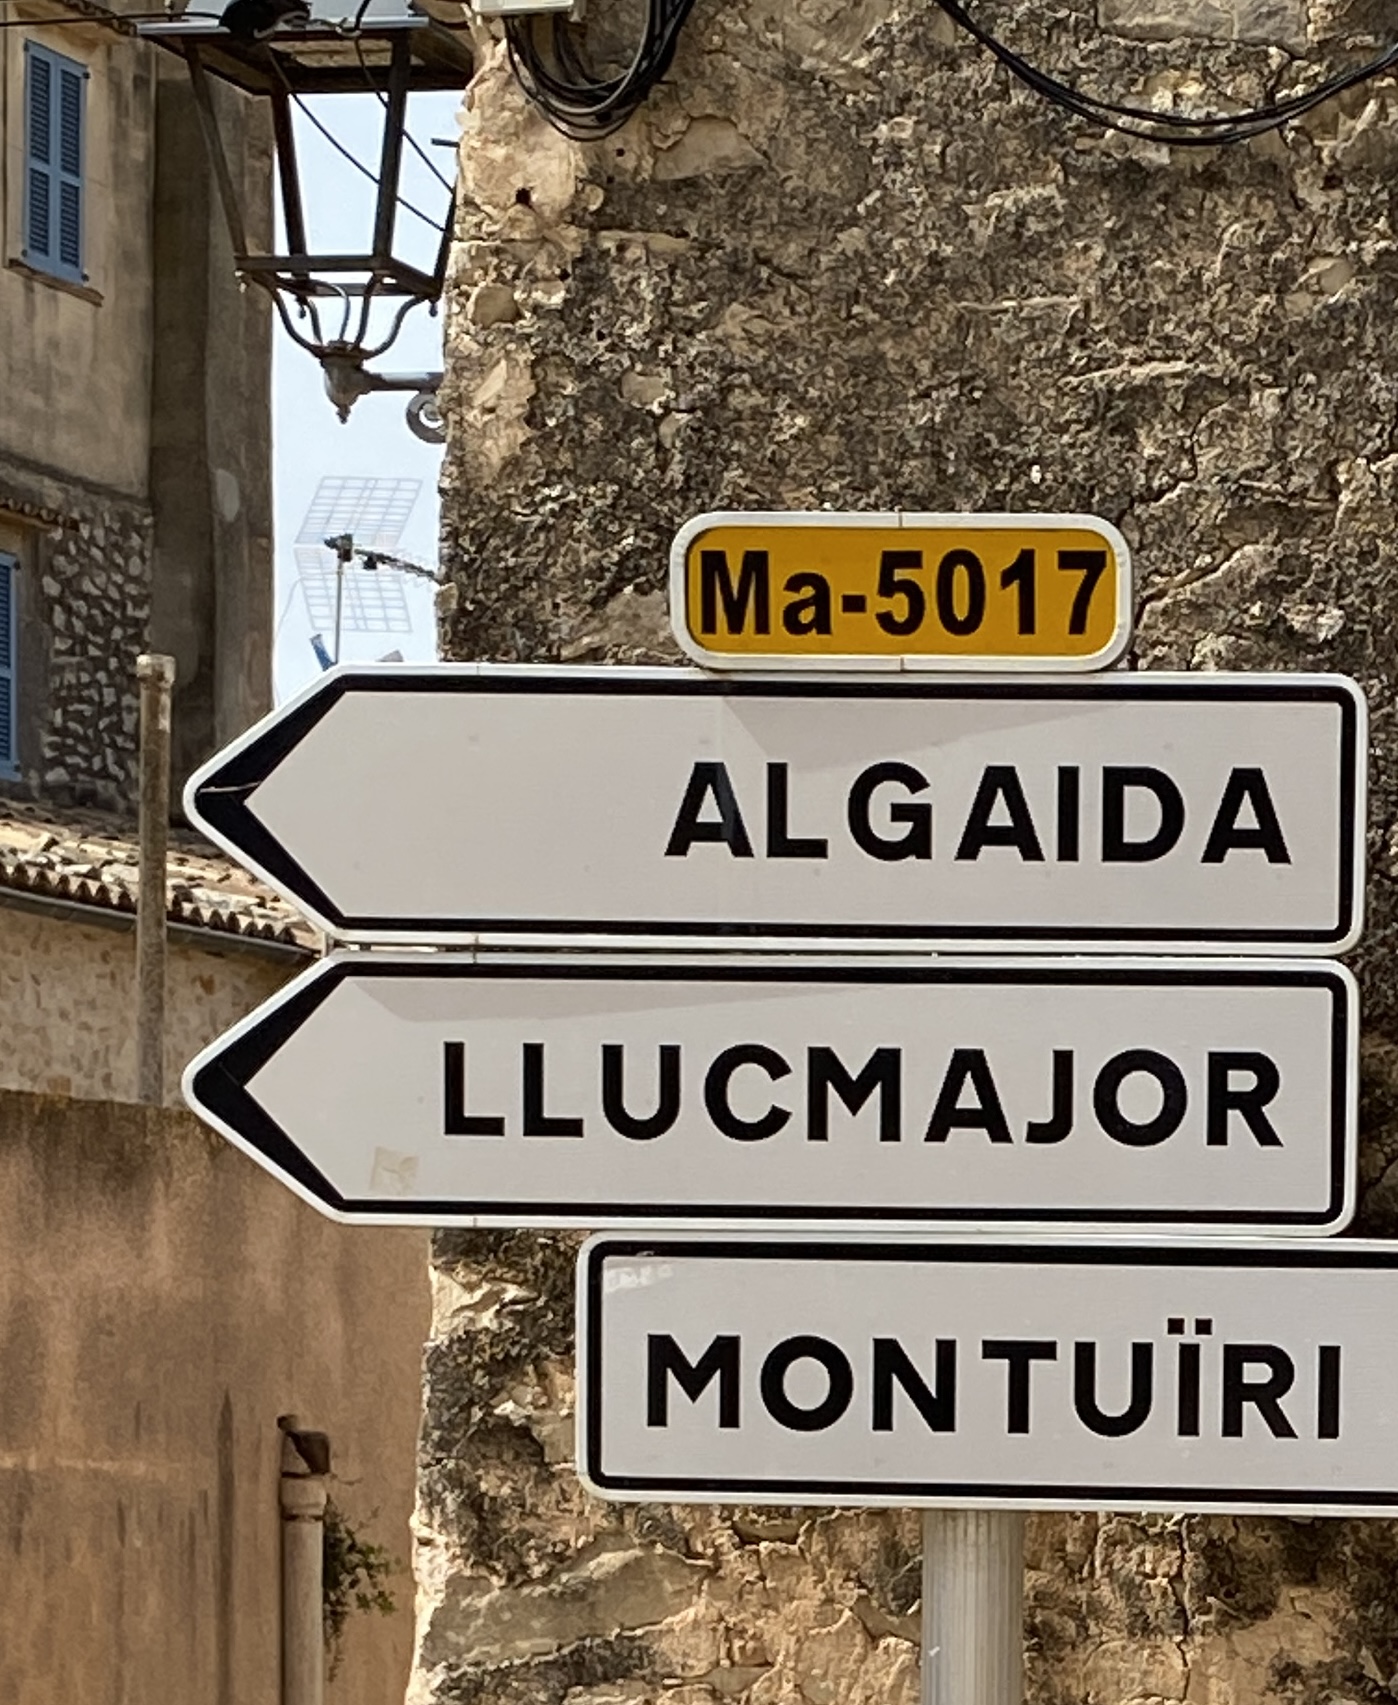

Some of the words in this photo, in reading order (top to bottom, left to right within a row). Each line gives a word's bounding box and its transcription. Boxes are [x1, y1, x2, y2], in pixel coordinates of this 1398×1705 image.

[700, 548, 1107, 636] Ma-5017
[665, 761, 1291, 864] ALGAIDA
[443, 1041, 1283, 1147] LLUCMAJOR
[647, 1317, 1340, 1439] MONTUÏRI
